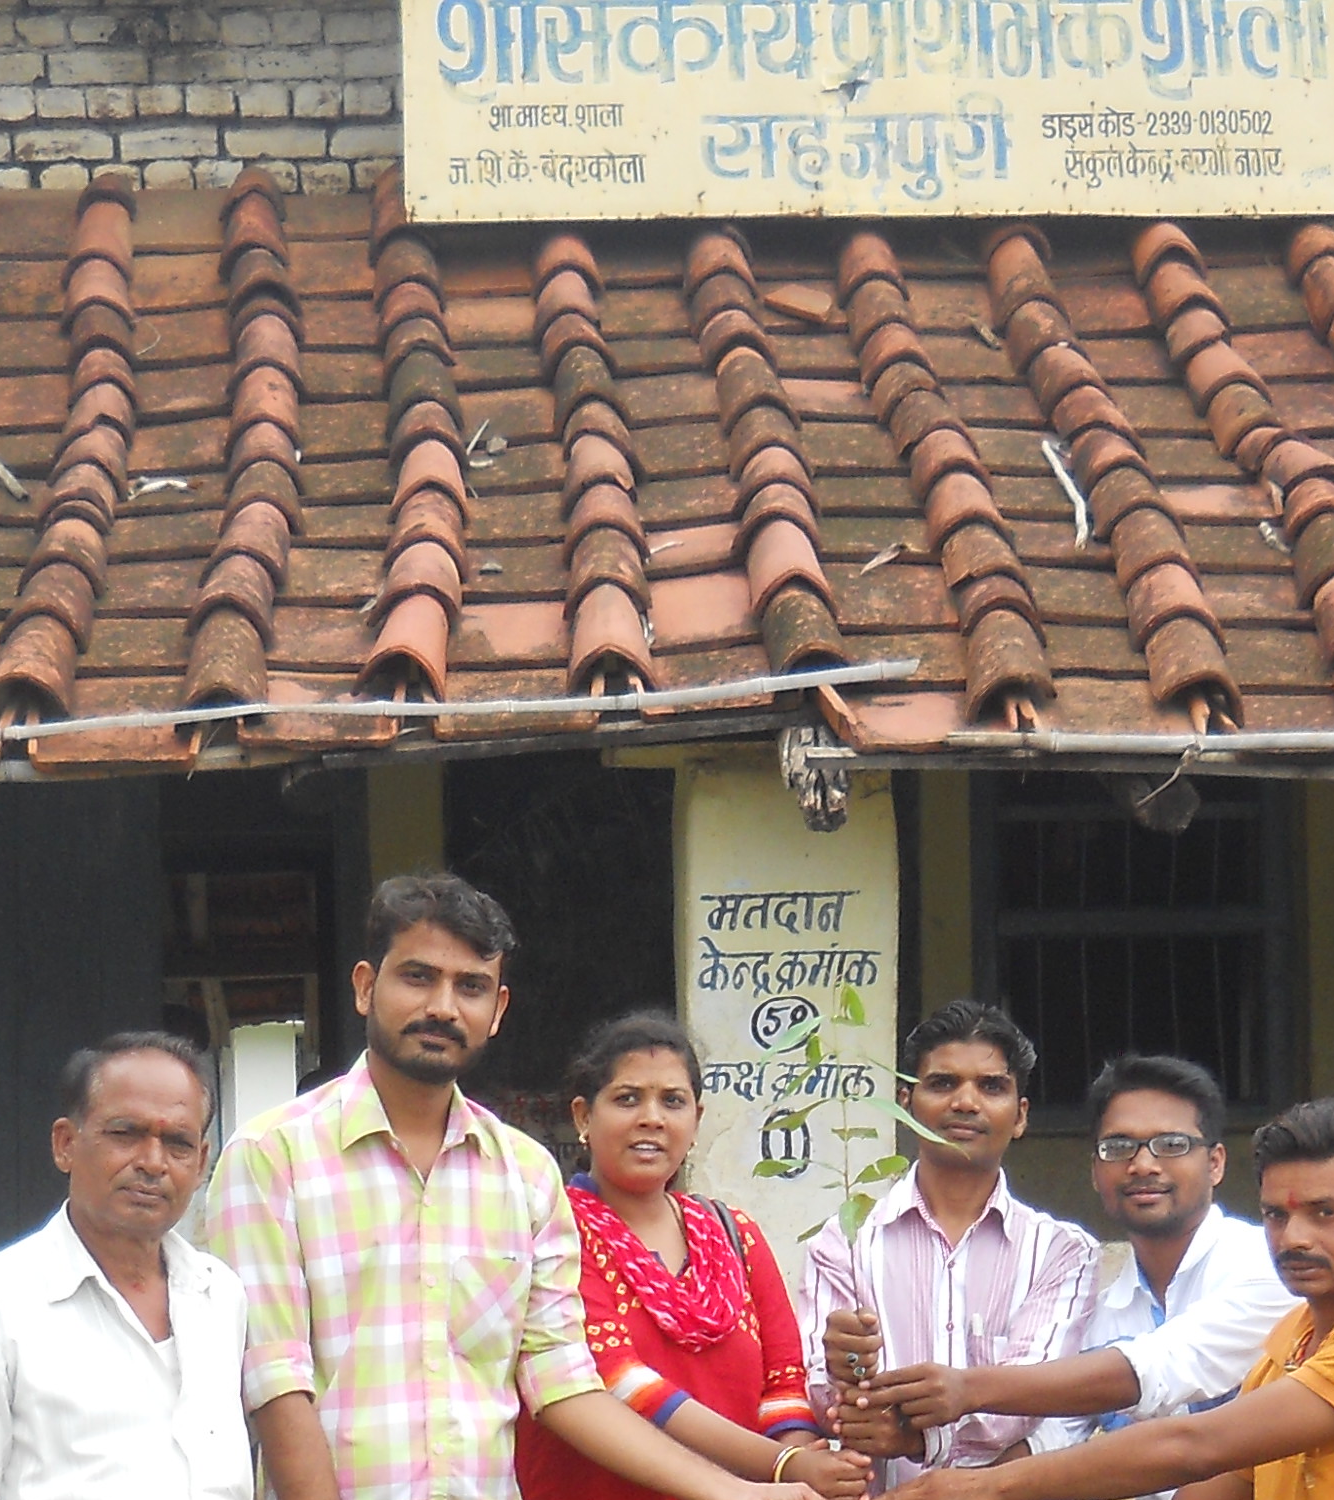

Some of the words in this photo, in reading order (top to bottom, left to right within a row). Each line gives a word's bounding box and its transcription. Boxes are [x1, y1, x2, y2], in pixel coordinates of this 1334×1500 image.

[1140, 0, 1330, 100] शाला
[700, 889, 860, 934] मतदान
[698, 936, 773, 998] केन्द्र
[775, 943, 882, 994] क्रमांक
[701, 1060, 772, 1101] कक्ष
[772, 1054, 876, 1103] क्रमांक
